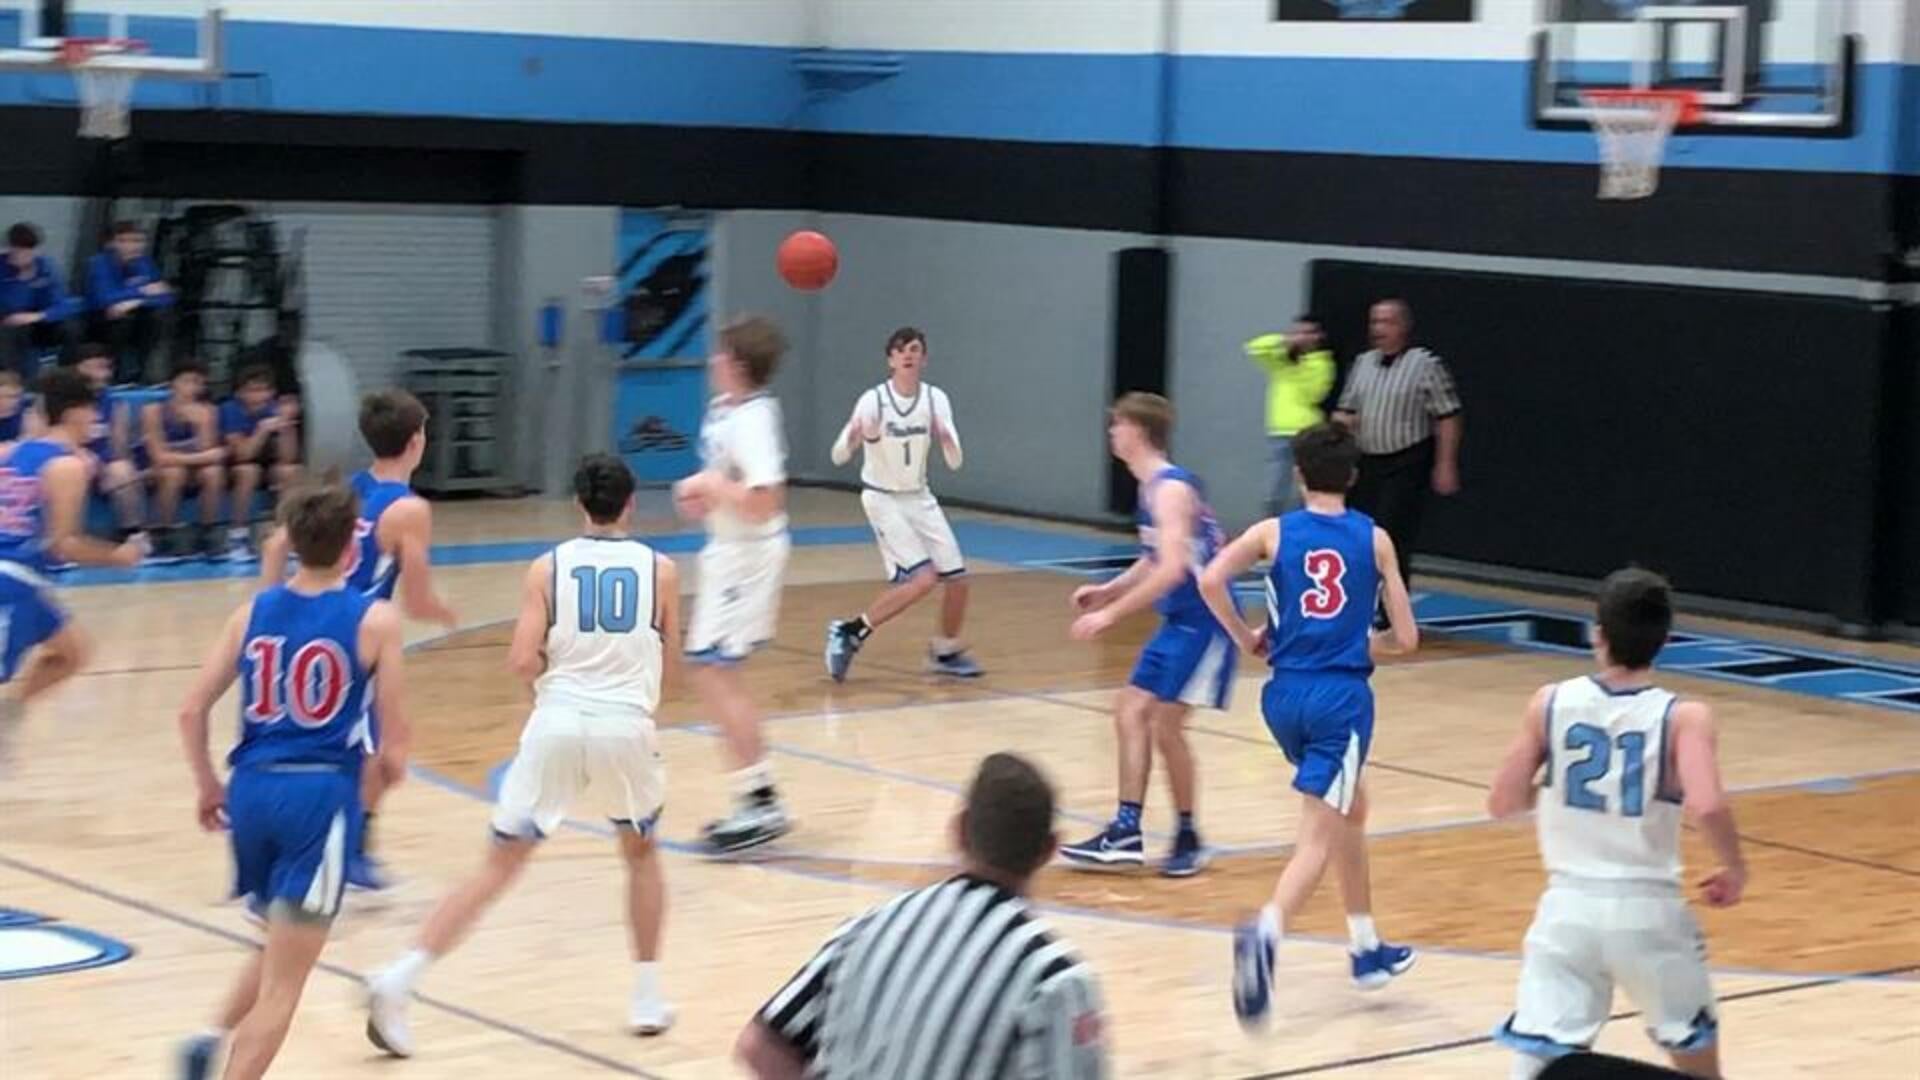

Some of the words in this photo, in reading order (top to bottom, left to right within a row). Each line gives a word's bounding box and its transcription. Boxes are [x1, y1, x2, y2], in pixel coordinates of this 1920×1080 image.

[902, 440, 911, 467] 1
[570, 565, 639, 633] 10
[1300, 548, 1347, 619] 3
[245, 636, 353, 728] 10
[1565, 722, 1645, 817] 21
